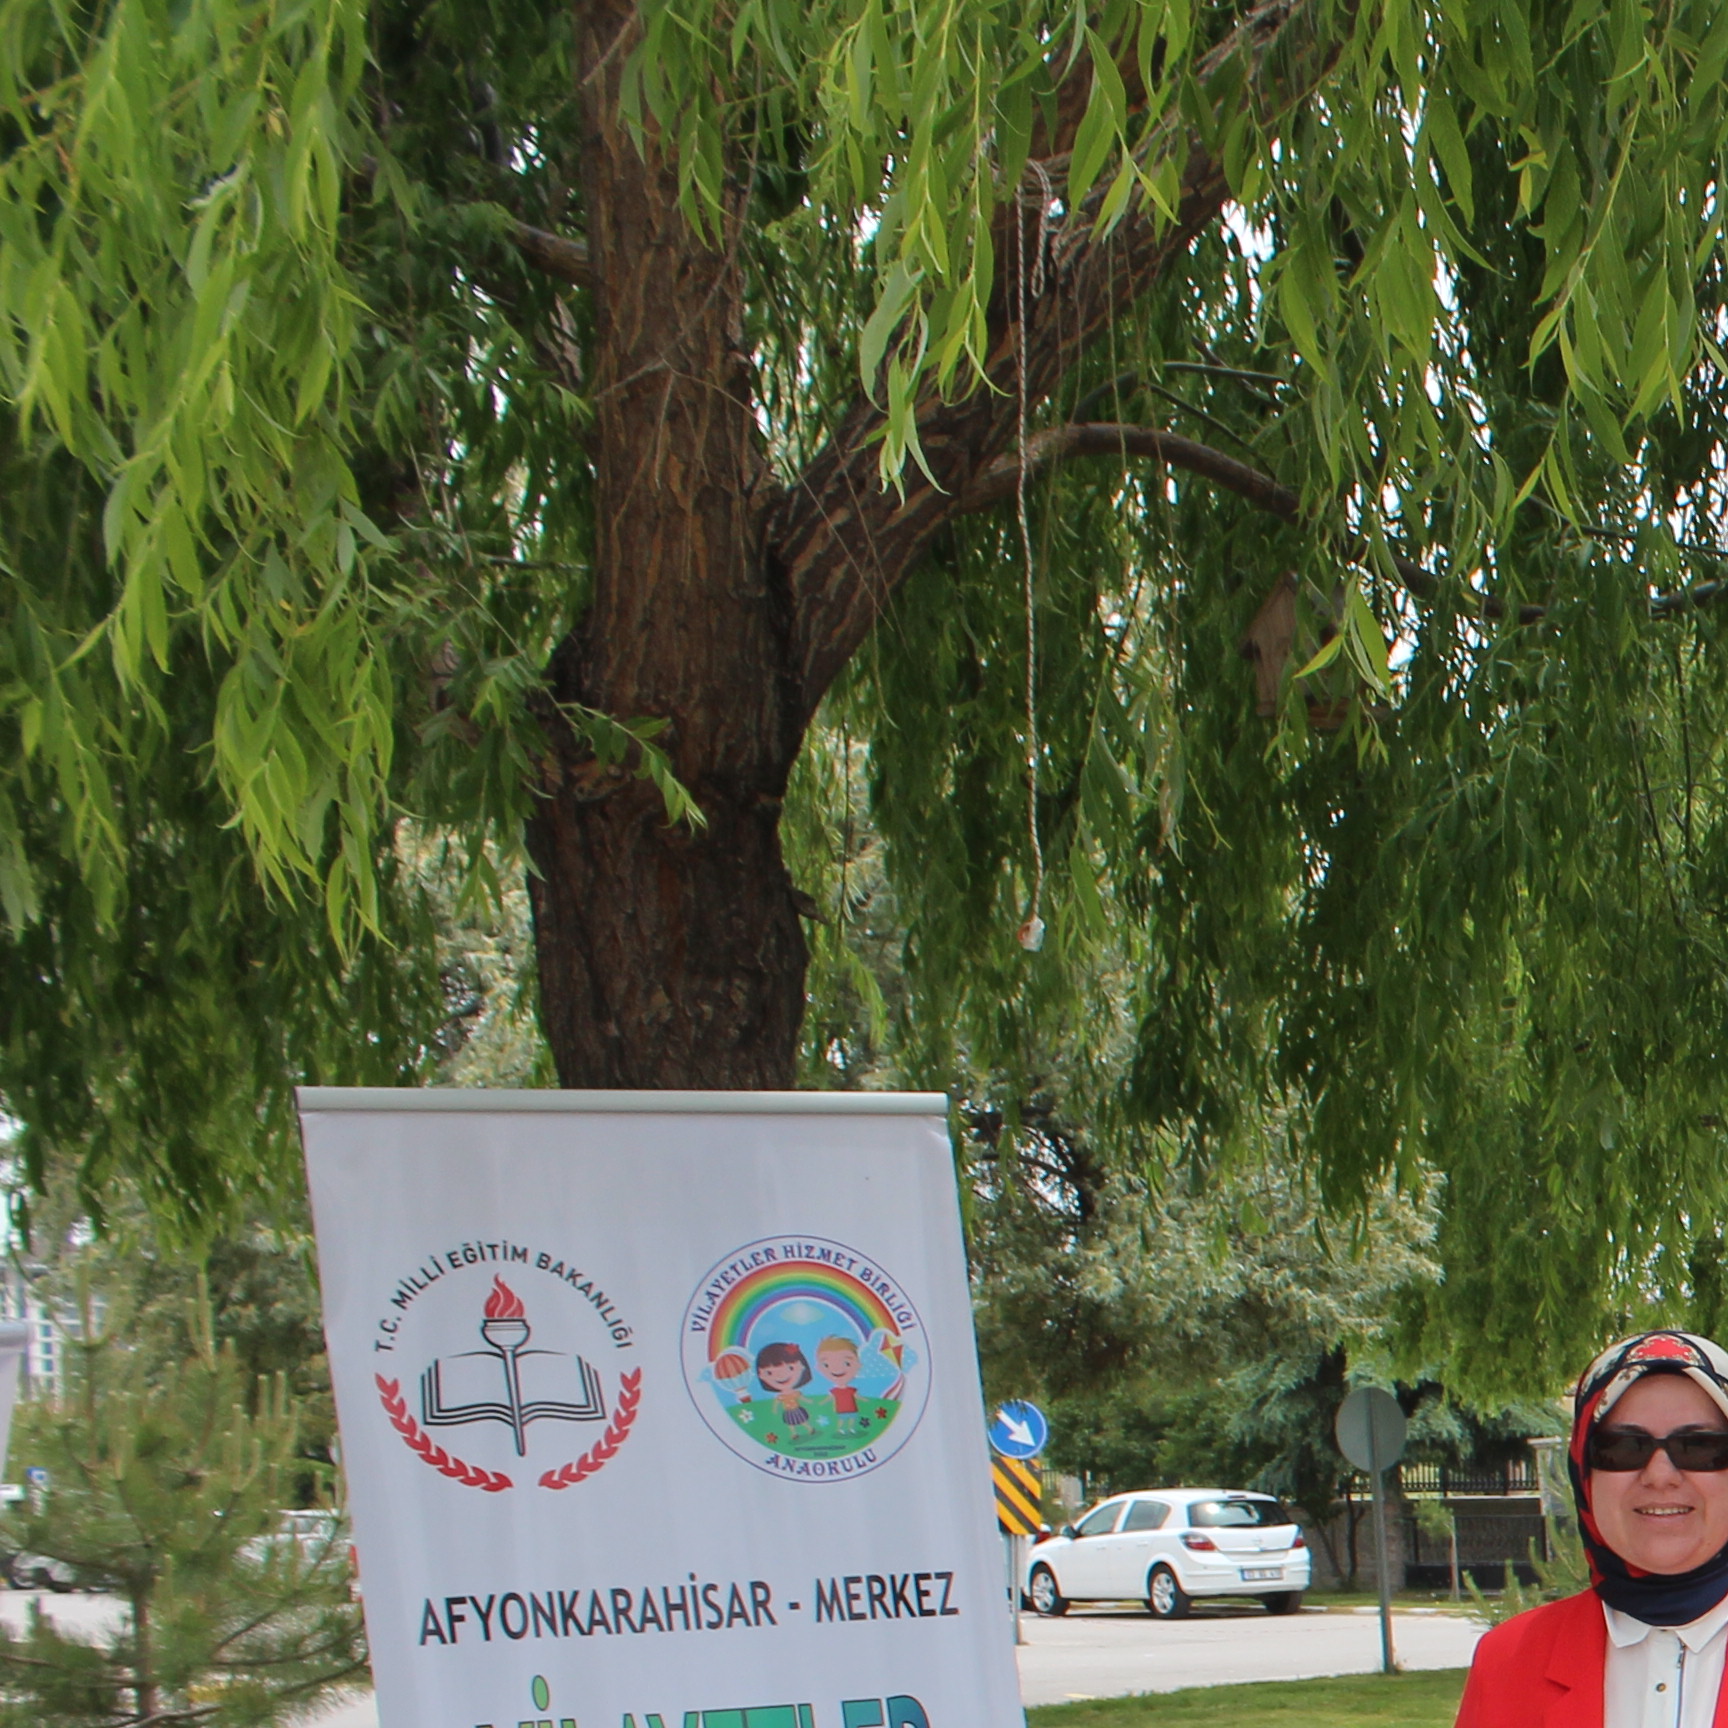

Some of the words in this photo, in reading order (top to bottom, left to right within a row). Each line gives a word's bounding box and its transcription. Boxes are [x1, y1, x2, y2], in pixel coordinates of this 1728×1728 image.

[375, 1314, 403, 1352] T.C.
[390, 1255, 444, 1310] MİLLİ
[446, 1240, 529, 1270] EĞİTİM
[535, 1251, 635, 1349] BAKANLIĞI
[690, 1243, 778, 1333] VİLAYETLER
[782, 1241, 859, 1271] HİZMET
[859, 1266, 917, 1331] BİRLİĞİ
[765, 1448, 878, 1477] ANAOKULU
[418, 1570, 778, 1646] AFYONKARAHİSAR
[814, 1571, 960, 1624] MERKEZ
